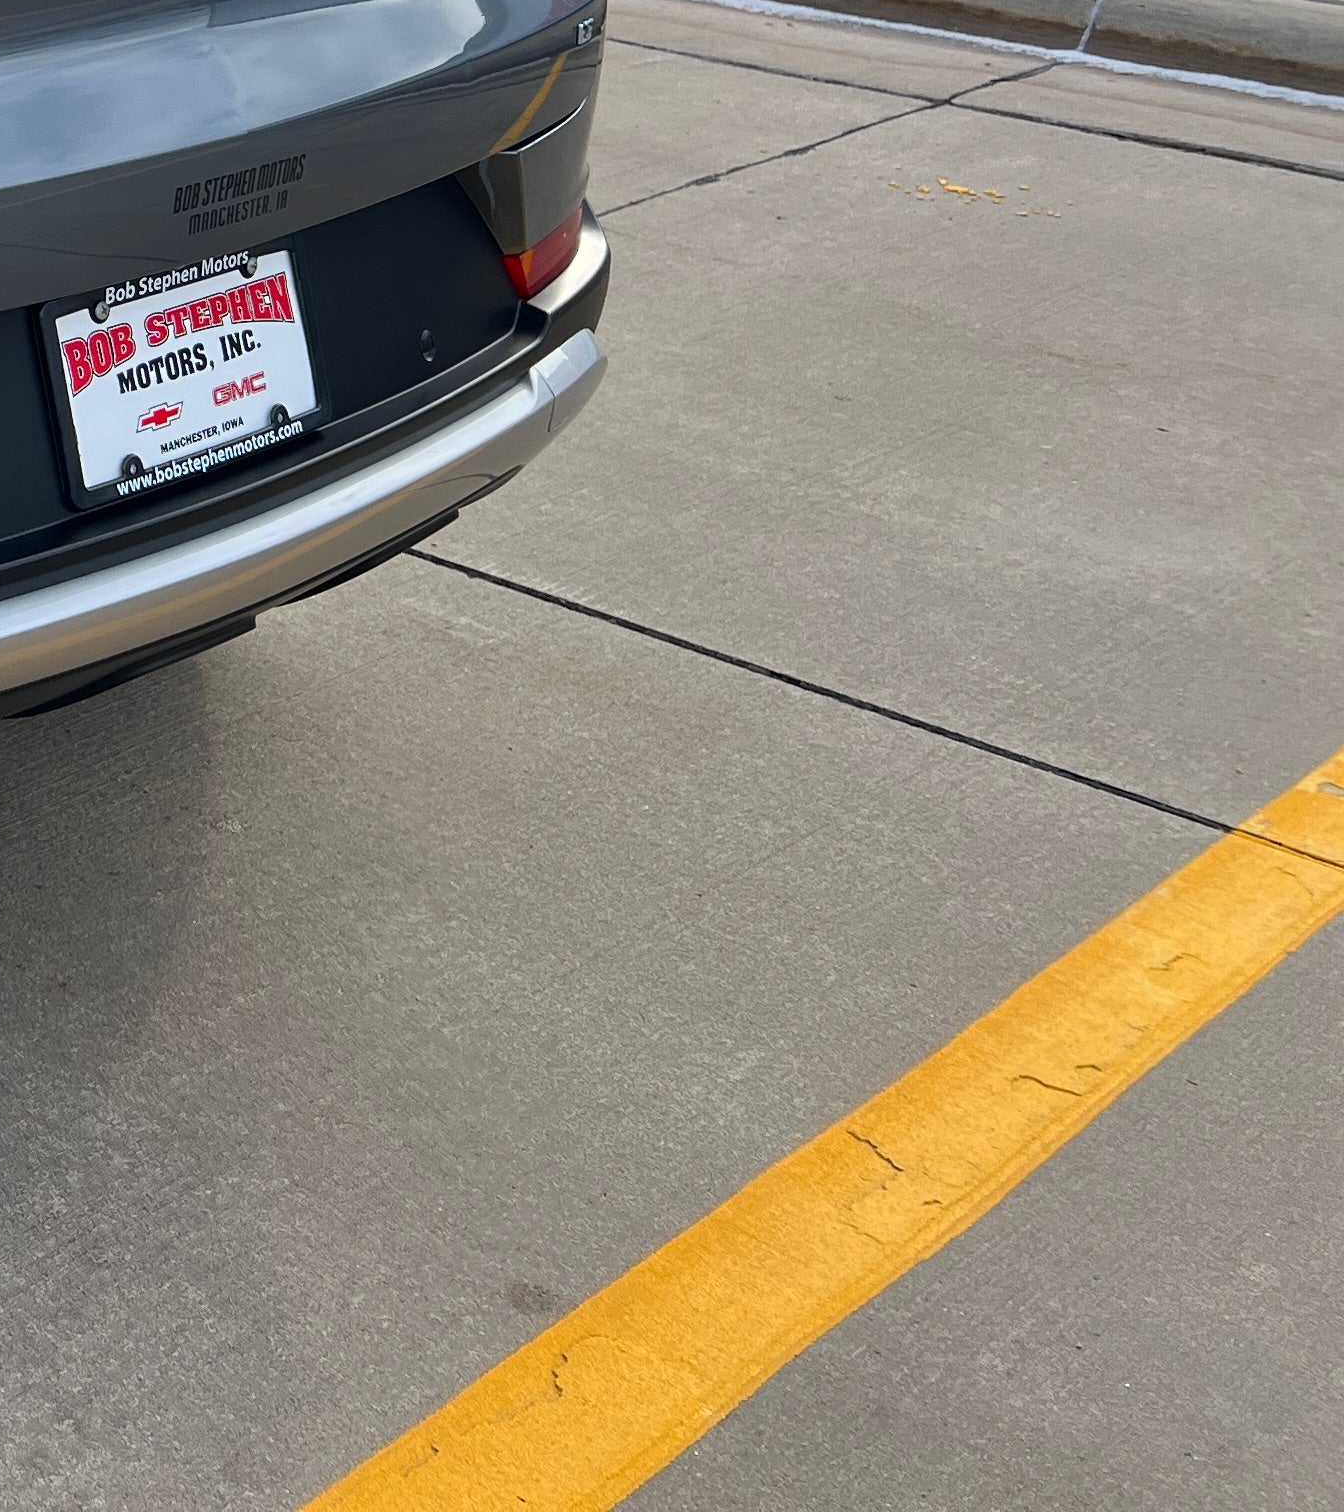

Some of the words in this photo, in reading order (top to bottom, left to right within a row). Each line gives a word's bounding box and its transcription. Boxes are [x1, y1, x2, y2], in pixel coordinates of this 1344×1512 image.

[173, 182, 201, 214] BOB
[202, 167, 257, 206] STEPHEN
[256, 153, 306, 190] MOTORS
[275, 189, 288, 211] IA
[105, 281, 136, 305] Bob
[138, 267, 198, 295] Stephen
[201, 250, 249, 277] Motors
[62, 323, 136, 397] BOB
[144, 271, 295, 347] STEPHEN
[116, 342, 215, 394] MOTORS,
[219, 329, 262, 362] INC.
[212, 371, 267, 407] GMC
[116, 419, 304, 497] www.bobstephenmotors.com
[160, 425, 221, 454] MANCHESTER,
[221, 416, 244, 433] IOWA
